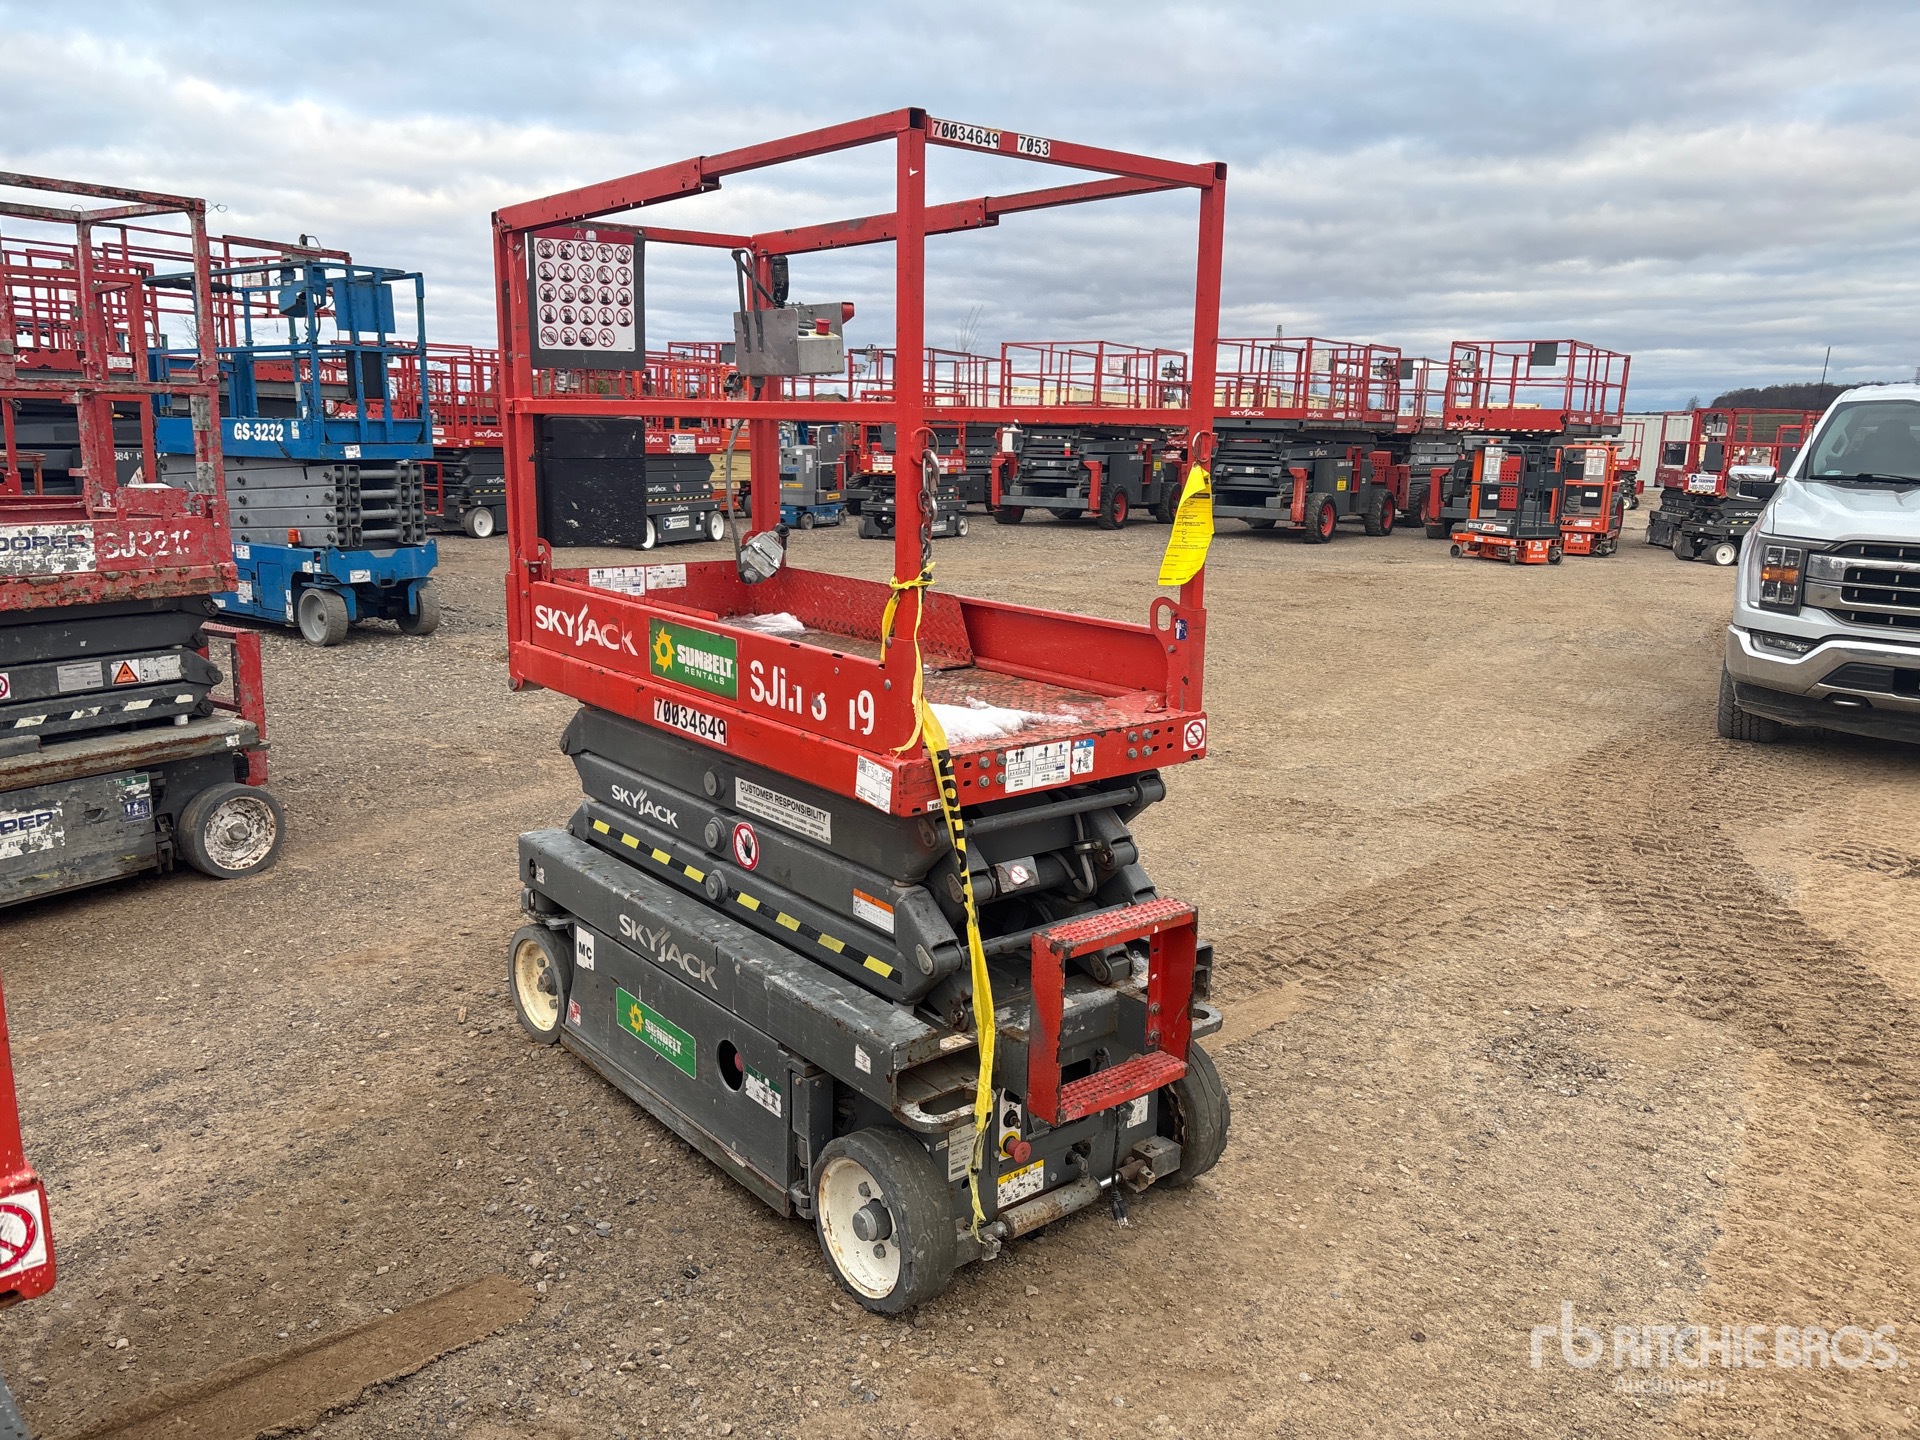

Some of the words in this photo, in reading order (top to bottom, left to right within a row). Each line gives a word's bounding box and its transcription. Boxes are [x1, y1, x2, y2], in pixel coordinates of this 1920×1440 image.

[933, 120, 999, 148] 70034649
[1019, 136, 1049, 156] 7053
[1230, 408, 1264, 417] SKYJACK
[233, 422, 284, 442] GS-3232
[474, 429, 503, 438] SKYJACK
[647, 485, 667, 493] SKYJACK
[535, 604, 639, 657] SKYJACK
[677, 644, 733, 679] SUNBELT
[684, 665, 725, 686] RENTALS
[655, 699, 726, 743] 70034649
[611, 784, 679, 829] SKYJACK
[740, 781, 774, 802] CUSTOMER
[774, 794, 827, 822] RESPONSIBILITY
[619, 913, 719, 991] SKYJACK
